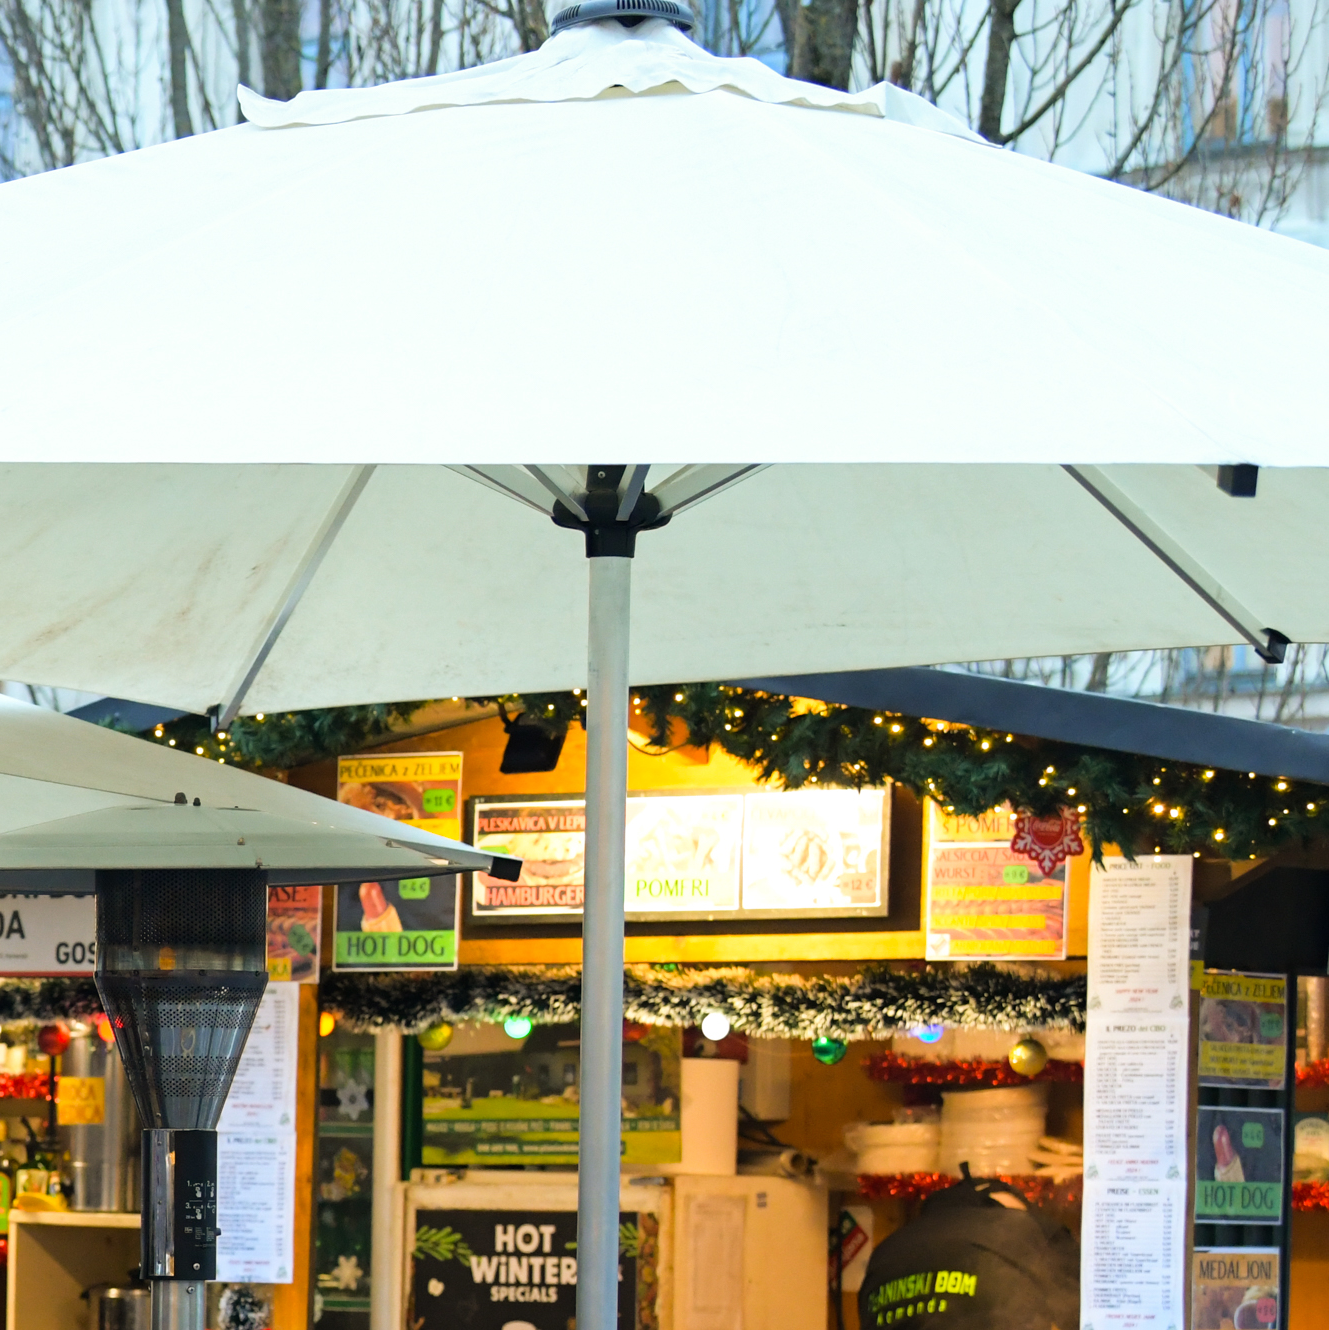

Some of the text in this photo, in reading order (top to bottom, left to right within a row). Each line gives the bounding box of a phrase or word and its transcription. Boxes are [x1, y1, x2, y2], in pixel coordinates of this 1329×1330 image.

[340, 760, 398, 779] PEČENICA
[412, 761, 461, 777] ZELJEM
[478, 816, 546, 832] PLESKAVICA
[956, 818, 1015, 834] POMFR
[934, 850, 989, 862] SALSICCIA
[934, 867, 976, 880] WURST
[268, 885, 308, 903] ASE:
[484, 885, 585, 906] HAMBURGER
[636, 878, 710, 898] POMFRI
[55, 941, 97, 965] GOS
[346, 934, 445, 957] HOT DOG
[1204, 1185, 1274, 1210] HOT DOG
[494, 1224, 556, 1254] HOT
[1198, 1259, 1273, 1281] MEDALJONI
[934, 1269, 978, 1297] DOM
